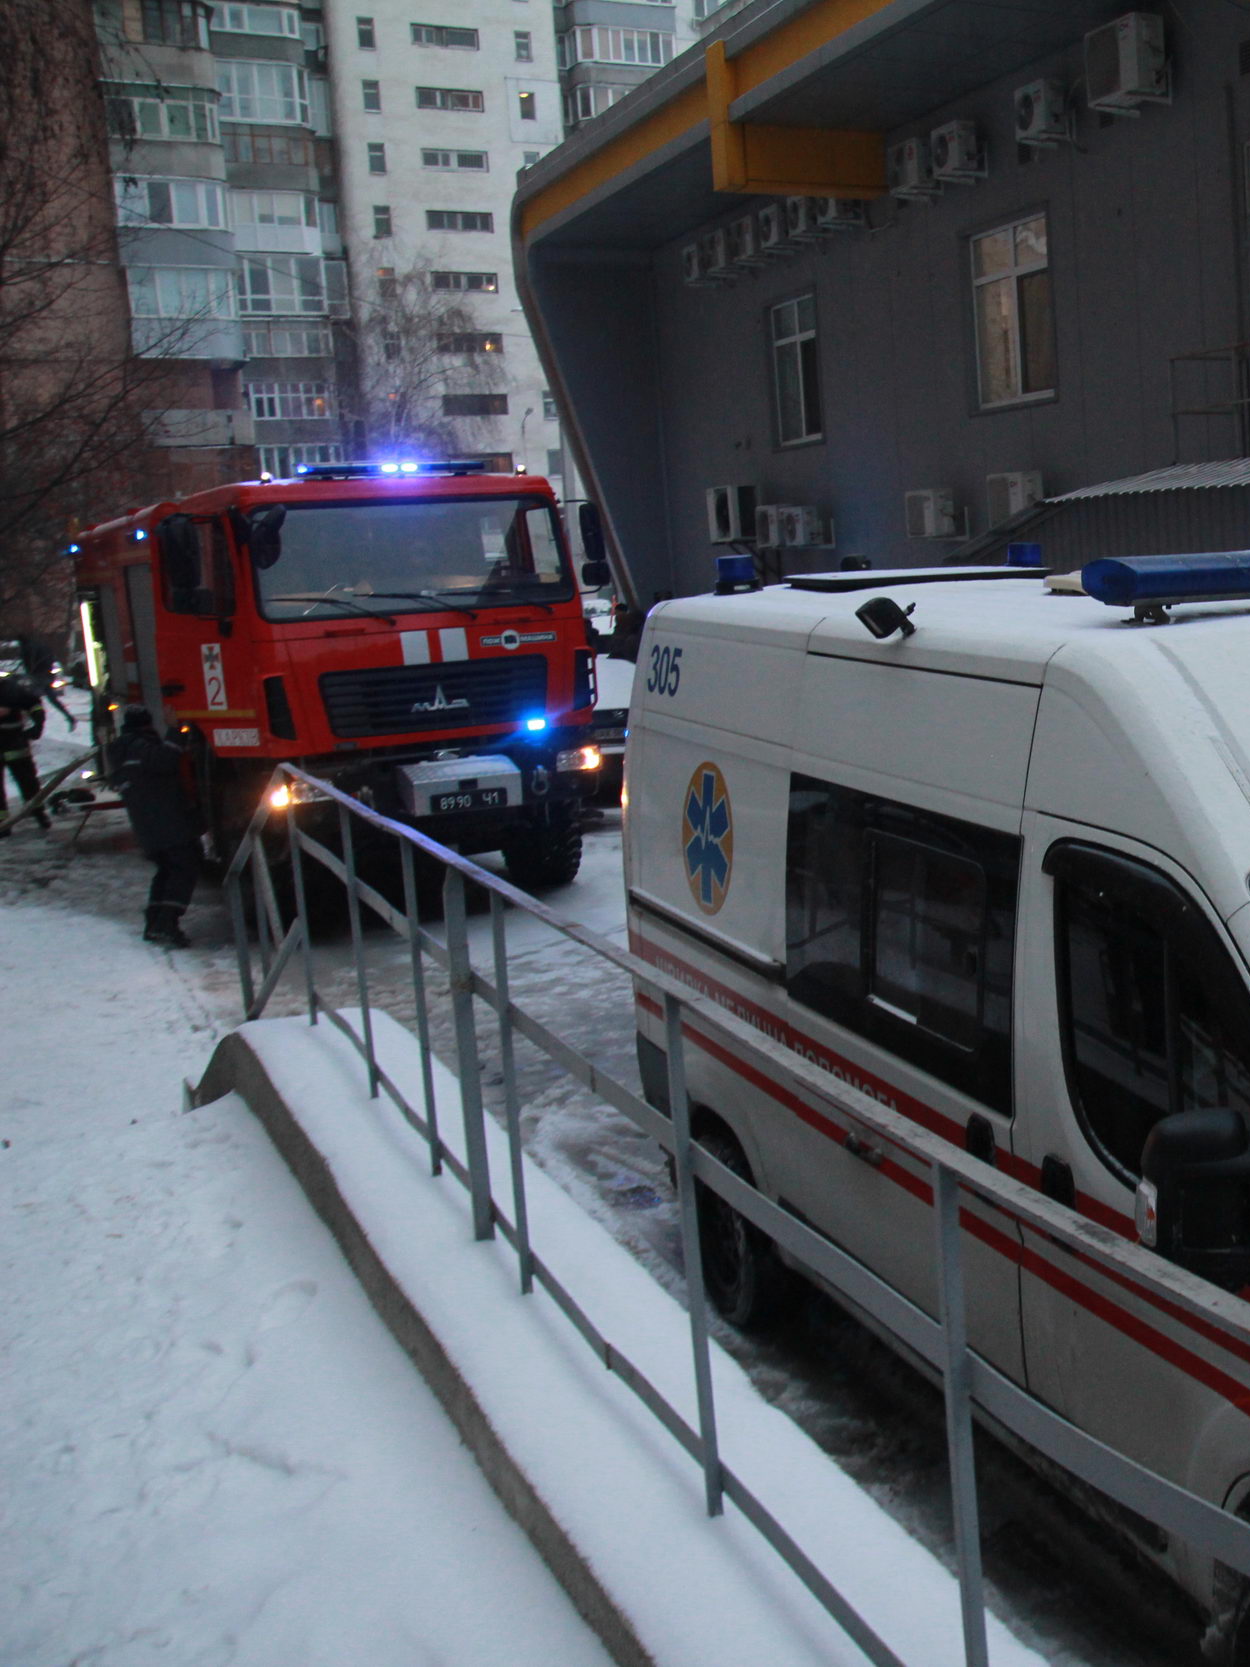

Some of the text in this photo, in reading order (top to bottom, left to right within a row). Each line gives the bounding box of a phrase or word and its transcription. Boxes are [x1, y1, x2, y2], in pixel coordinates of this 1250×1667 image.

[647, 644, 683, 697] 305
[208, 676, 224, 706] 2
[440, 794, 473, 810] 8990
